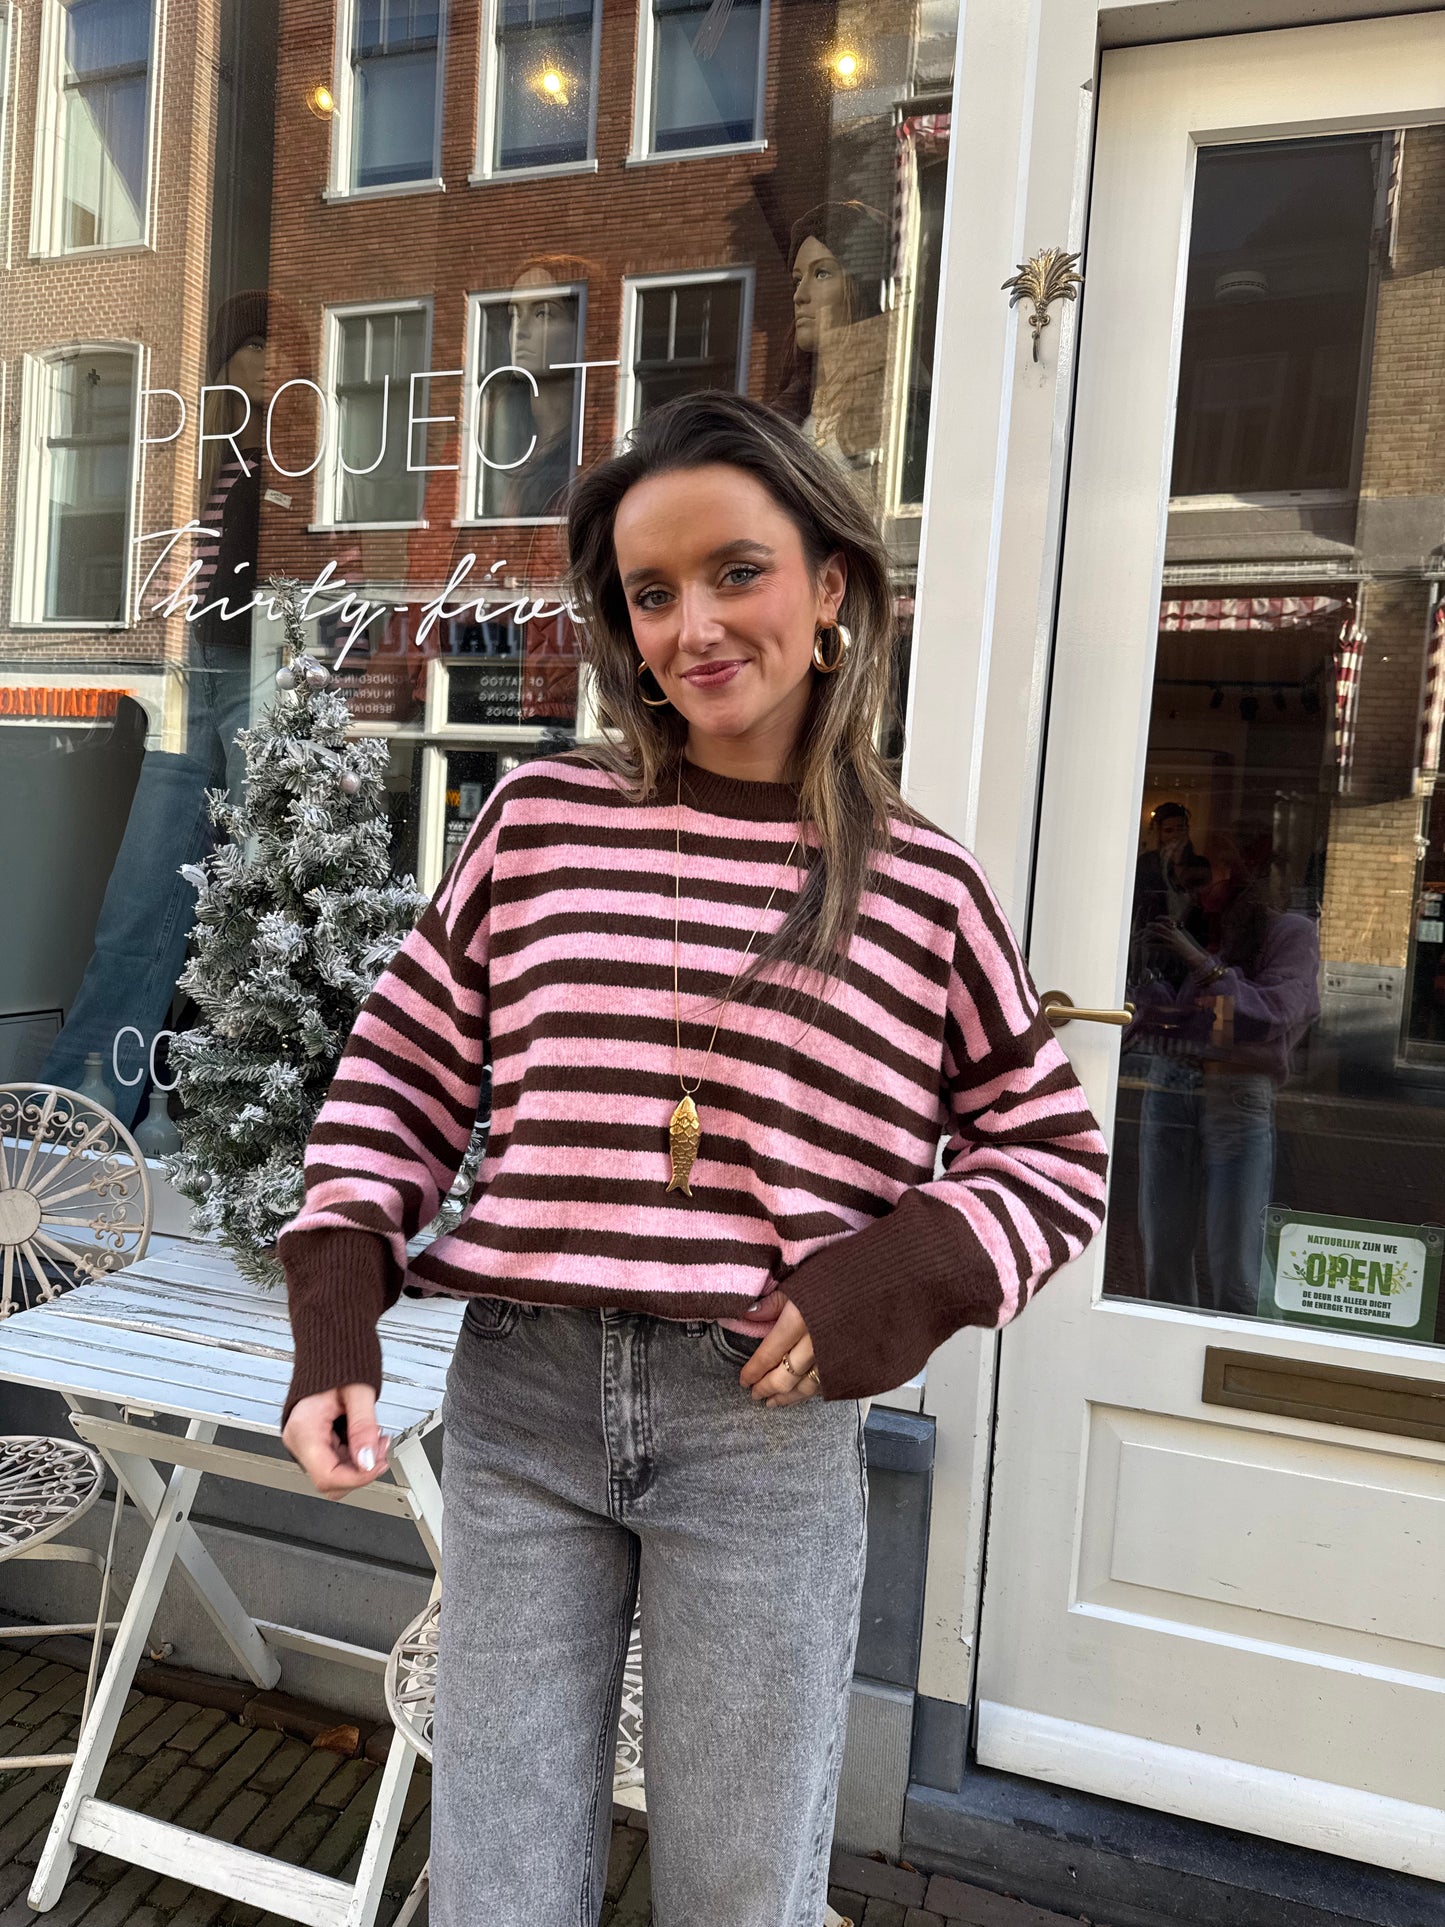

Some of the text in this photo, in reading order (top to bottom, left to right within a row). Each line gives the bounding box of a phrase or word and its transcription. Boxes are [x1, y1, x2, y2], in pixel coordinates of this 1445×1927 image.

[136, 360, 621, 481] PROJECT
[1307, 1234, 1398, 1254] NATUURLIJK ZIJN WE
[1305, 1253, 1393, 1296] OPEN
[1301, 1300, 1391, 1319] OM ENERGIE TE BESPAREN
[1302, 1290, 1392, 1309] DE DEUR IS ALLEEN DICHT
